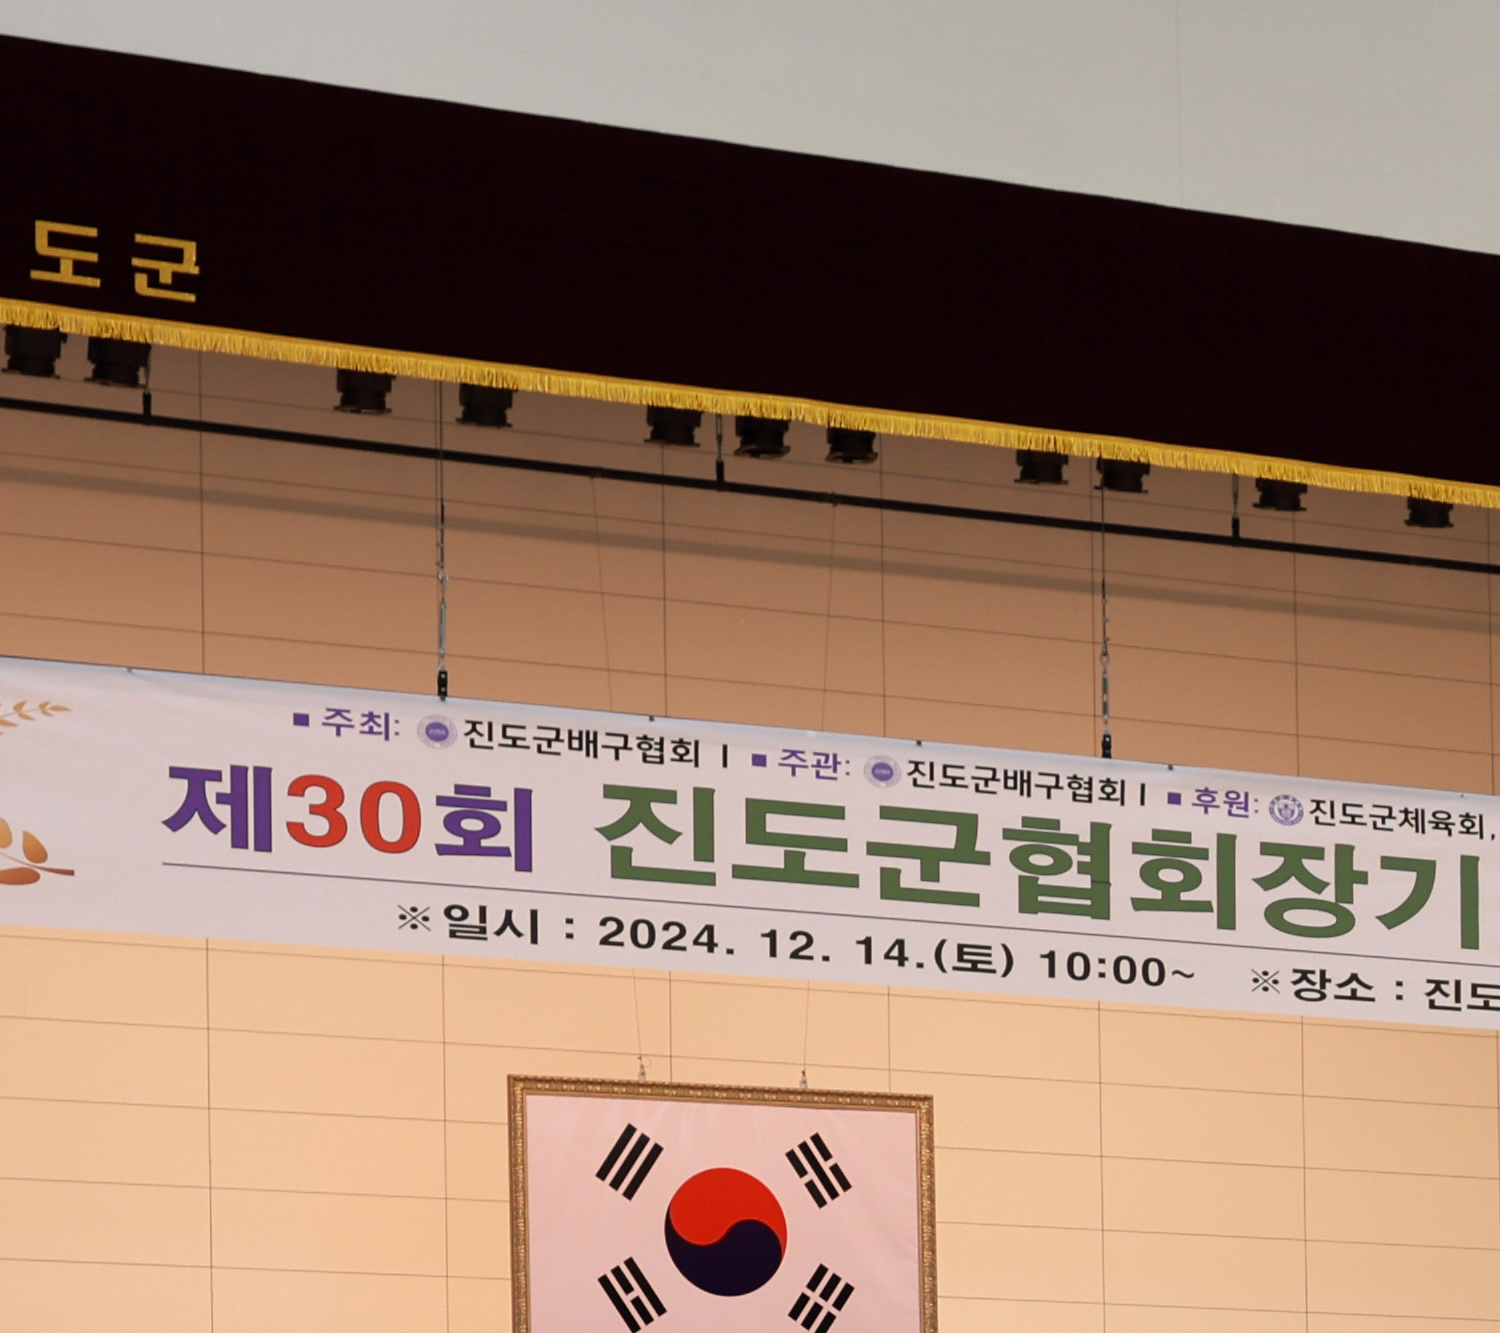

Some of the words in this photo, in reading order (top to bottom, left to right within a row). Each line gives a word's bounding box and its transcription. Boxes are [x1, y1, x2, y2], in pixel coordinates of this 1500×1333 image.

[321, 706, 401, 741] 주최:
[463, 718, 701, 768] 진도군배구협회
[777, 747, 851, 781] 주관:
[906, 758, 1126, 806] 진도군배구협회
[1191, 786, 1260, 818] 후원:
[1308, 798, 1496, 843] 진도군체육회,
[161, 763, 534, 873] 제30회
[594, 783, 1480, 951] 진도군협회장기
[598, 915, 735, 956] 2024.
[760, 928, 831, 962] 12.
[1039, 949, 1195, 987] 10:00~
